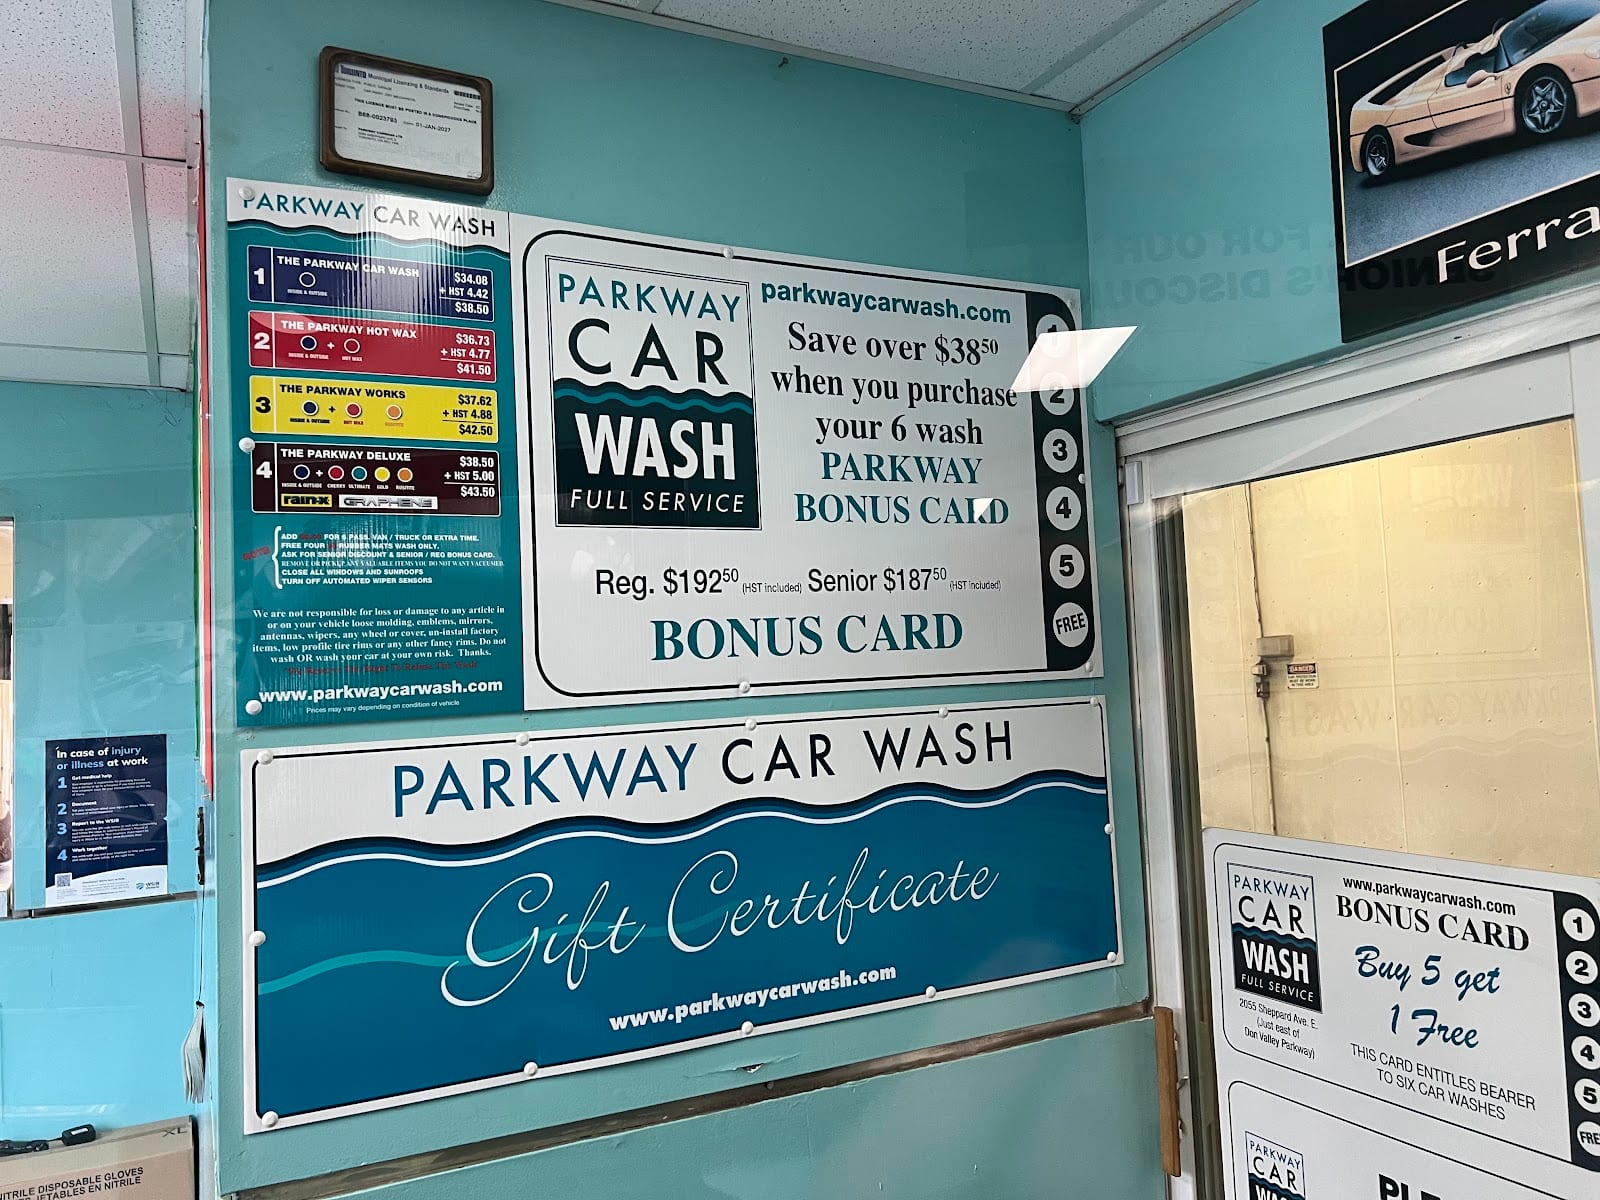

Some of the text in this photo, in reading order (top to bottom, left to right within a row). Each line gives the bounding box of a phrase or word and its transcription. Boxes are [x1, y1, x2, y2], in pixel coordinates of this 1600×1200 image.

[373, 206, 419, 226] CAR
[429, 214, 495, 237] WASH
[253, 267, 264, 285] 1
[276, 255, 418, 277] THE PARKWAY CAR WASH
[454, 273, 488, 286] $34.08
[448, 286, 489, 299] HST 4.42
[558, 274, 740, 321] PARKWAY
[454, 301, 489, 315] $38.50
[761, 284, 1010, 323] parkwaycarwash.com
[281, 320, 417, 339] THE PARKWAY HOT WAX
[455, 333, 490, 346] $36.73
[253, 332, 271, 350] 2
[568, 317, 729, 385] CAR
[788, 322, 856, 355] Save
[865, 338, 926, 361] over
[450, 347, 490, 360] HST 4.77
[456, 362, 491, 376] $41.50
[279, 384, 405, 399] THE PARKWAY WORKS
[770, 367, 1017, 407] when you purchase
[255, 396, 271, 414] 3
[458, 394, 492, 407] $37.62
[452, 409, 492, 420] HST 4.88
[459, 423, 493, 436] $42.50
[815, 414, 983, 445] your 6 wash
[280, 448, 411, 462] THE PARKWAY DELUXE
[574, 414, 735, 479] WASH
[1052, 438, 1068, 462] 3
[255, 461, 272, 479] 4
[459, 456, 494, 468] $38.50
[820, 452, 983, 484] PARKWAY
[453, 470, 494, 482] HST 5.00
[460, 486, 495, 498] $43.50
[570, 488, 744, 513] FULL SERVICE
[343, 497, 433, 508] GRAPHENE
[793, 493, 910, 524] BONUS
[1055, 496, 1071, 519] 4
[1058, 554, 1074, 577] 5
[596, 569, 654, 600] Reg.
[742, 582, 762, 595] (HST
[764, 582, 802, 594] included)
[808, 568, 877, 592] Senior
[949, 580, 967, 592] (HST
[968, 580, 1001, 591] included)
[252, 609, 268, 618] We
[288, 610, 303, 618] not
[306, 608, 357, 619] responsible
[359, 607, 373, 616] for
[374, 607, 391, 616] loss
[404, 607, 438, 616] damage
[440, 607, 449, 615] to
[451, 608, 466, 616] any
[468, 605, 495, 614] article
[496, 605, 504, 614] in
[1055, 613, 1087, 633] FREE
[649, 613, 962, 660] BONUS CARD
[258, 680, 503, 703] www.parkwaycarwash.com
[56, 746, 141, 759] In case of injury
[56, 756, 148, 771] or illness at work
[394, 721, 1012, 818] PARKWAY CAR WASH
[57, 776, 67, 789] 1
[57, 802, 67, 816] 2
[56, 822, 67, 835] 3
[56, 849, 68, 861] 4
[1234, 874, 1310, 901] PARKWAY
[1342, 878, 1515, 915] www.parkwaycarwash.com
[1238, 896, 1304, 933] CAR
[1335, 895, 1529, 951] BONUS CARD
[440, 847, 999, 1007] Gift Certificate
[1572, 916, 1583, 934] 1
[1241, 940, 1309, 983] WASH
[1574, 959, 1590, 977] 2
[1354, 945, 1501, 1001] Buy 5 get
[1241, 973, 1313, 1002] FULL SERVICE
[608, 967, 897, 1030] www.parkwaycarwash.com
[1239, 997, 1256, 1011] 2055
[1293, 1013, 1308, 1027] Ave.
[1577, 1002, 1592, 1019] 3
[1391, 1005, 1479, 1048] 1 Free
[1259, 1031, 1279, 1048] Valley
[1580, 1045, 1595, 1062] 4
[1350, 1042, 1535, 1110] THIS CARD ENTITLES BEARER
[1376, 1068, 1505, 1120] TO SIX CAR WASHES
[1583, 1088, 1598, 1104] 5
[162, 1127, 187, 1138] XL
[1250, 1140, 1301, 1170] PARKWAY
[38, 1174, 101, 1194] DISPOSABLE
[104, 1166, 143, 1181] GLOVES
[1253, 1156, 1298, 1191] CAR
[88, 1183, 101, 1193] EN
[104, 1176, 141, 1190] NITRILE
